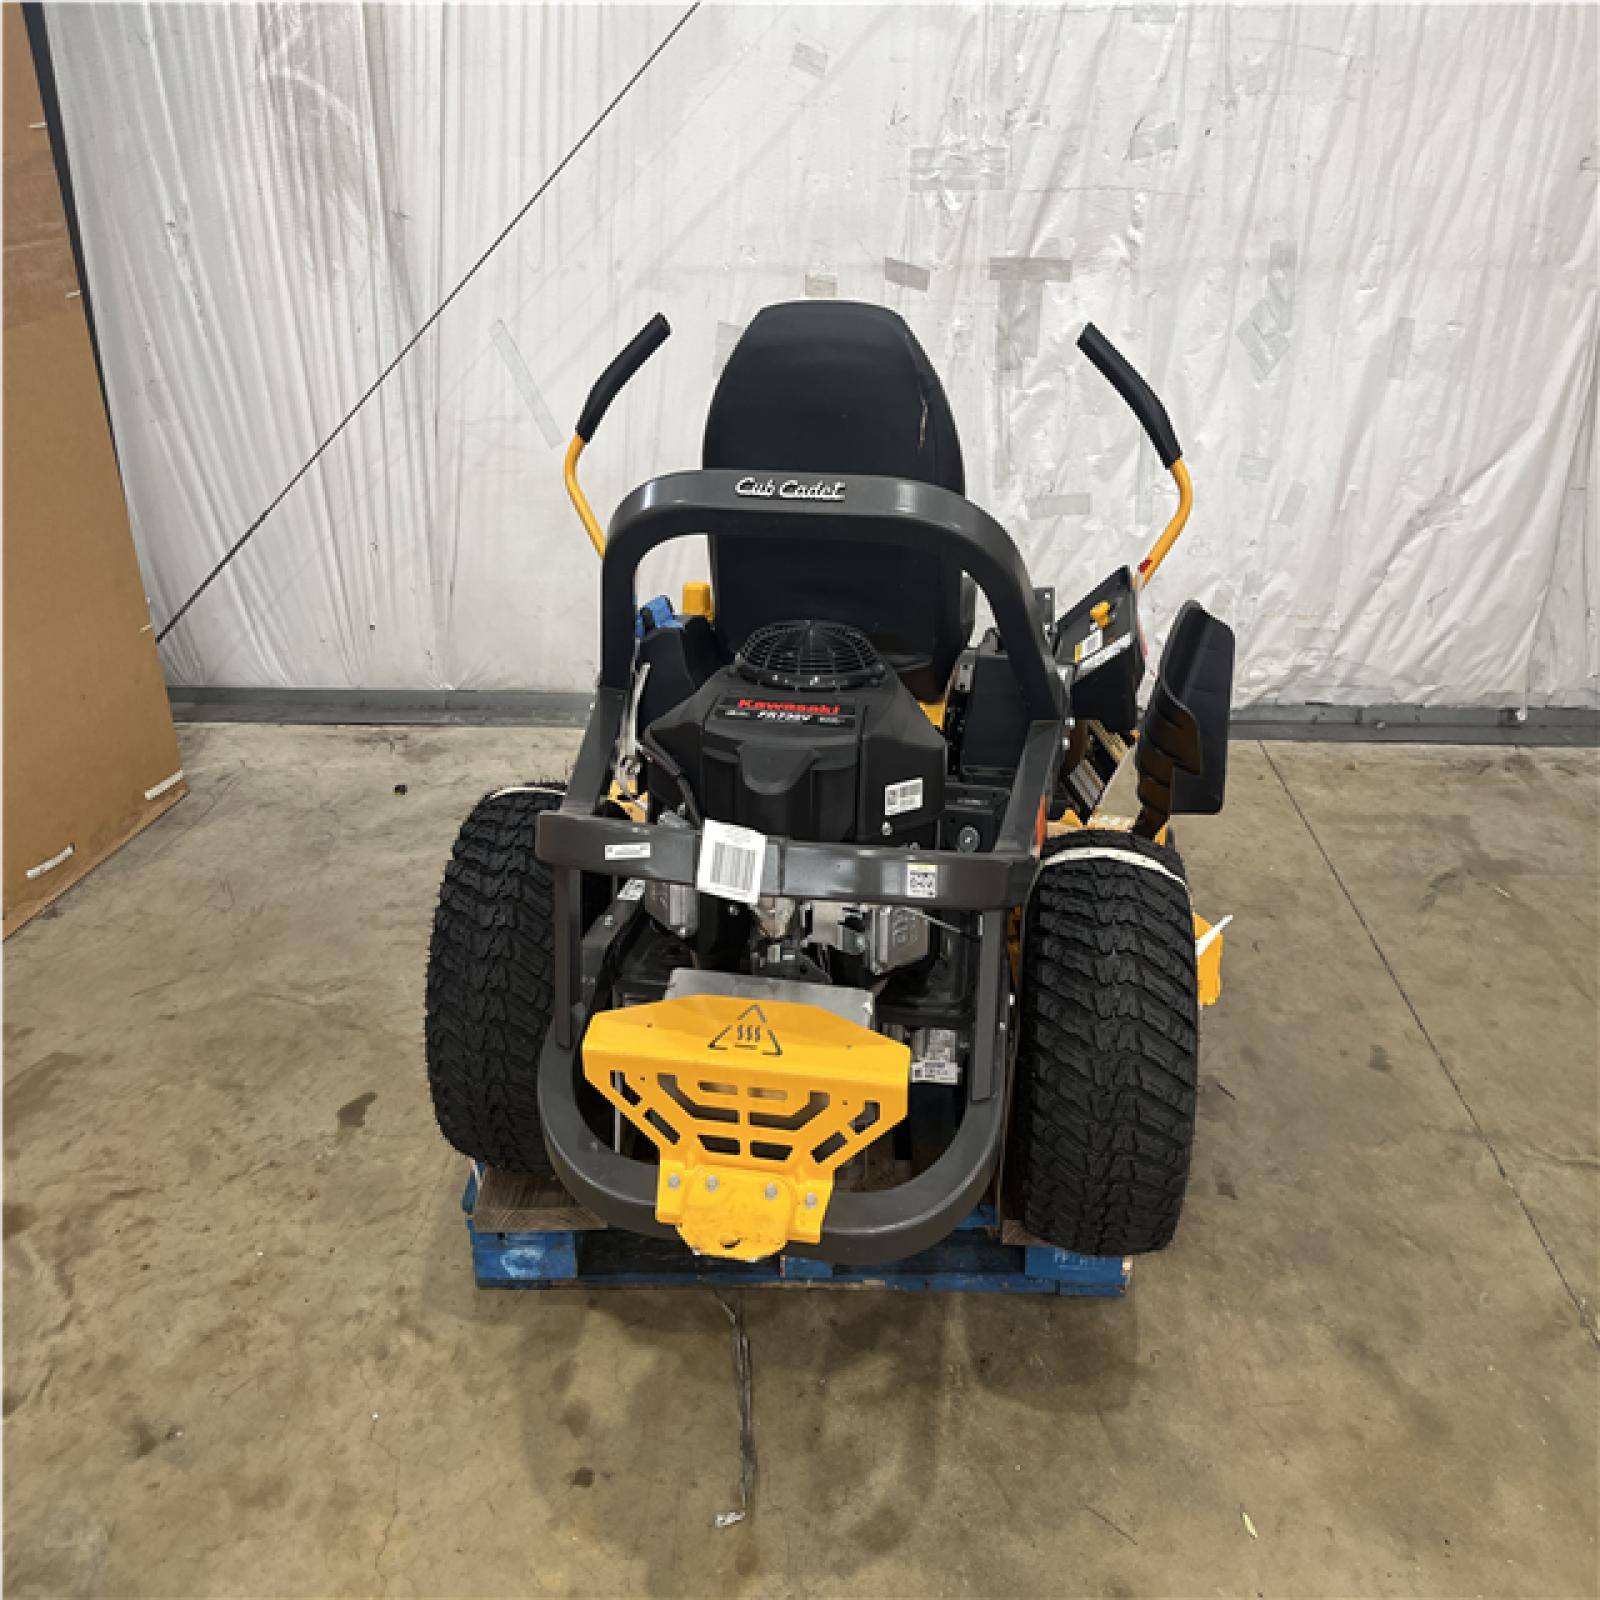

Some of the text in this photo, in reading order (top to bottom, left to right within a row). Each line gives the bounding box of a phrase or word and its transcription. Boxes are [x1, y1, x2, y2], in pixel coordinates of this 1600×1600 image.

[735, 477, 845, 501] Cub Cadet
[737, 699, 840, 715] Kawasaki
